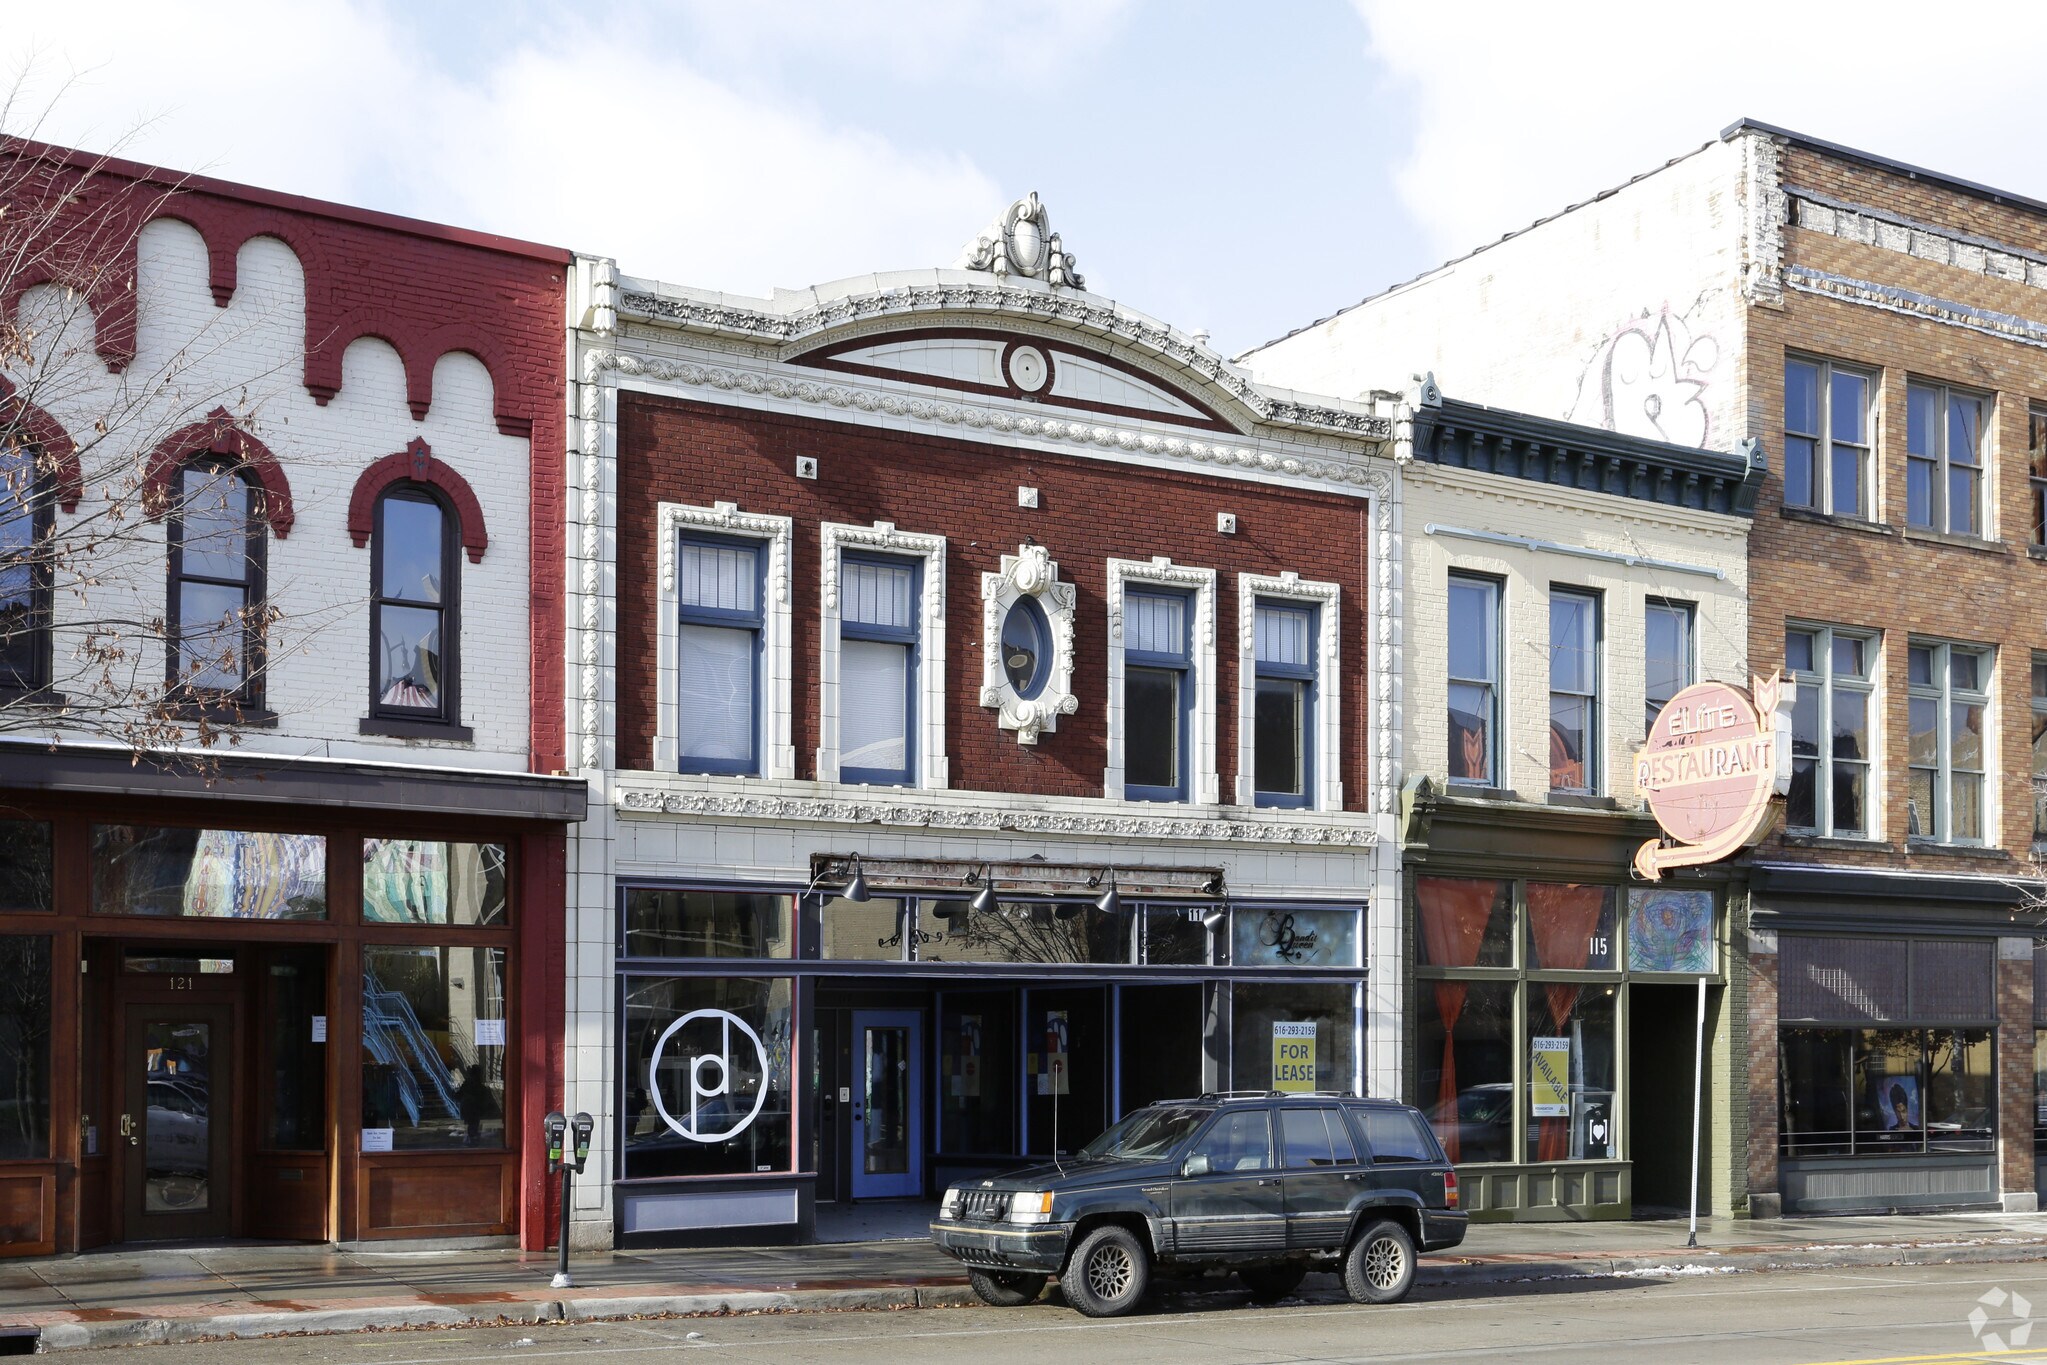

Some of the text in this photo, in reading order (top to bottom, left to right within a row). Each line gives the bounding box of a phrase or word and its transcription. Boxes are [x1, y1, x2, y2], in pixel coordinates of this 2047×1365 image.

[1637, 739, 1773, 792] RESTAURANT
[1590, 937, 1608, 955] 115
[170, 977, 192, 990] 121
[1274, 1025, 1316, 1036] 616-293-2159
[1280, 1044, 1309, 1059] FOR
[1533, 1040, 1569, 1050] 616-293-2159
[1275, 1064, 1314, 1081] LEASE
[1532, 1052, 1568, 1103] AVAILABLE
